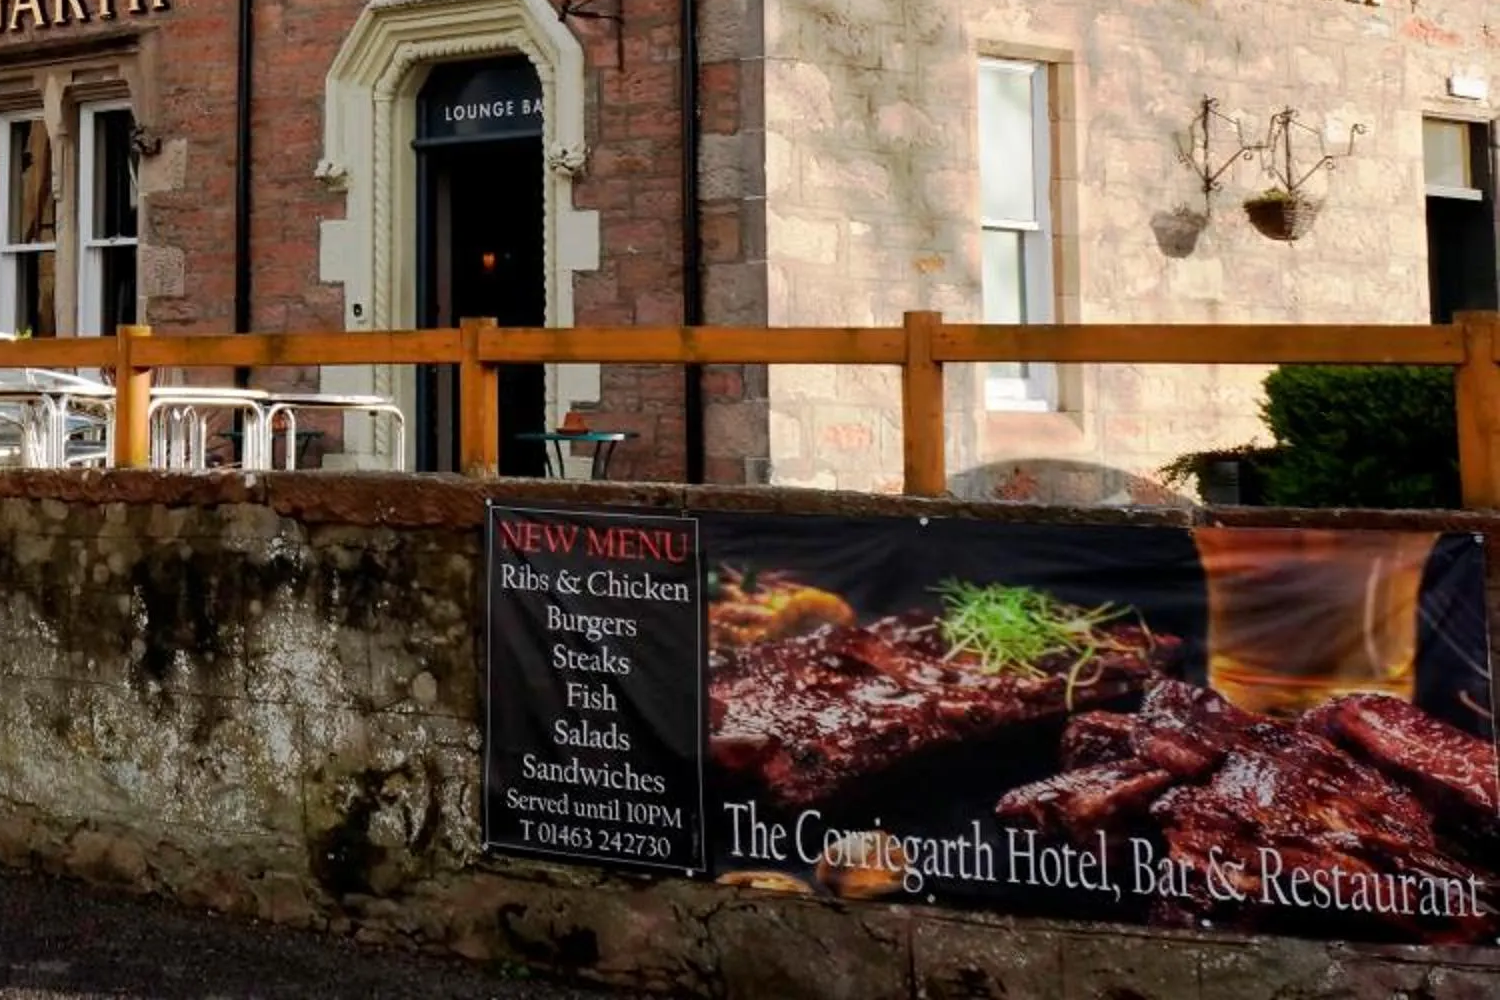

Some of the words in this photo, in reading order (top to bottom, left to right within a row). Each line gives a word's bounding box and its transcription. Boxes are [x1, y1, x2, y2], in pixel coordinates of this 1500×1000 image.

[444, 100, 514, 121] LOUNGE
[521, 98, 544, 115] BA
[500, 519, 580, 554] NEW
[584, 526, 689, 564] MENU
[501, 563, 549, 591] Ribs
[556, 569, 582, 595] &
[587, 570, 690, 603] Chicken
[547, 604, 637, 642] Burgers
[552, 643, 631, 676] Steaks
[566, 682, 618, 712] Fish
[554, 719, 631, 752] Salads
[523, 753, 666, 795] Sandwiches
[506, 787, 569, 815] Served
[573, 799, 621, 821] until
[626, 801, 683, 829] 10PM
[519, 819, 535, 841] T
[537, 822, 593, 849] 01463
[598, 829, 672, 858] 242730
[723, 800, 788, 860] The
[795, 808, 998, 893] Corriegarth
[1004, 826, 1121, 902] Hotel,
[1129, 836, 1195, 899] Bar
[1205, 845, 1248, 901] &
[1257, 846, 1488, 918] Restaurant
